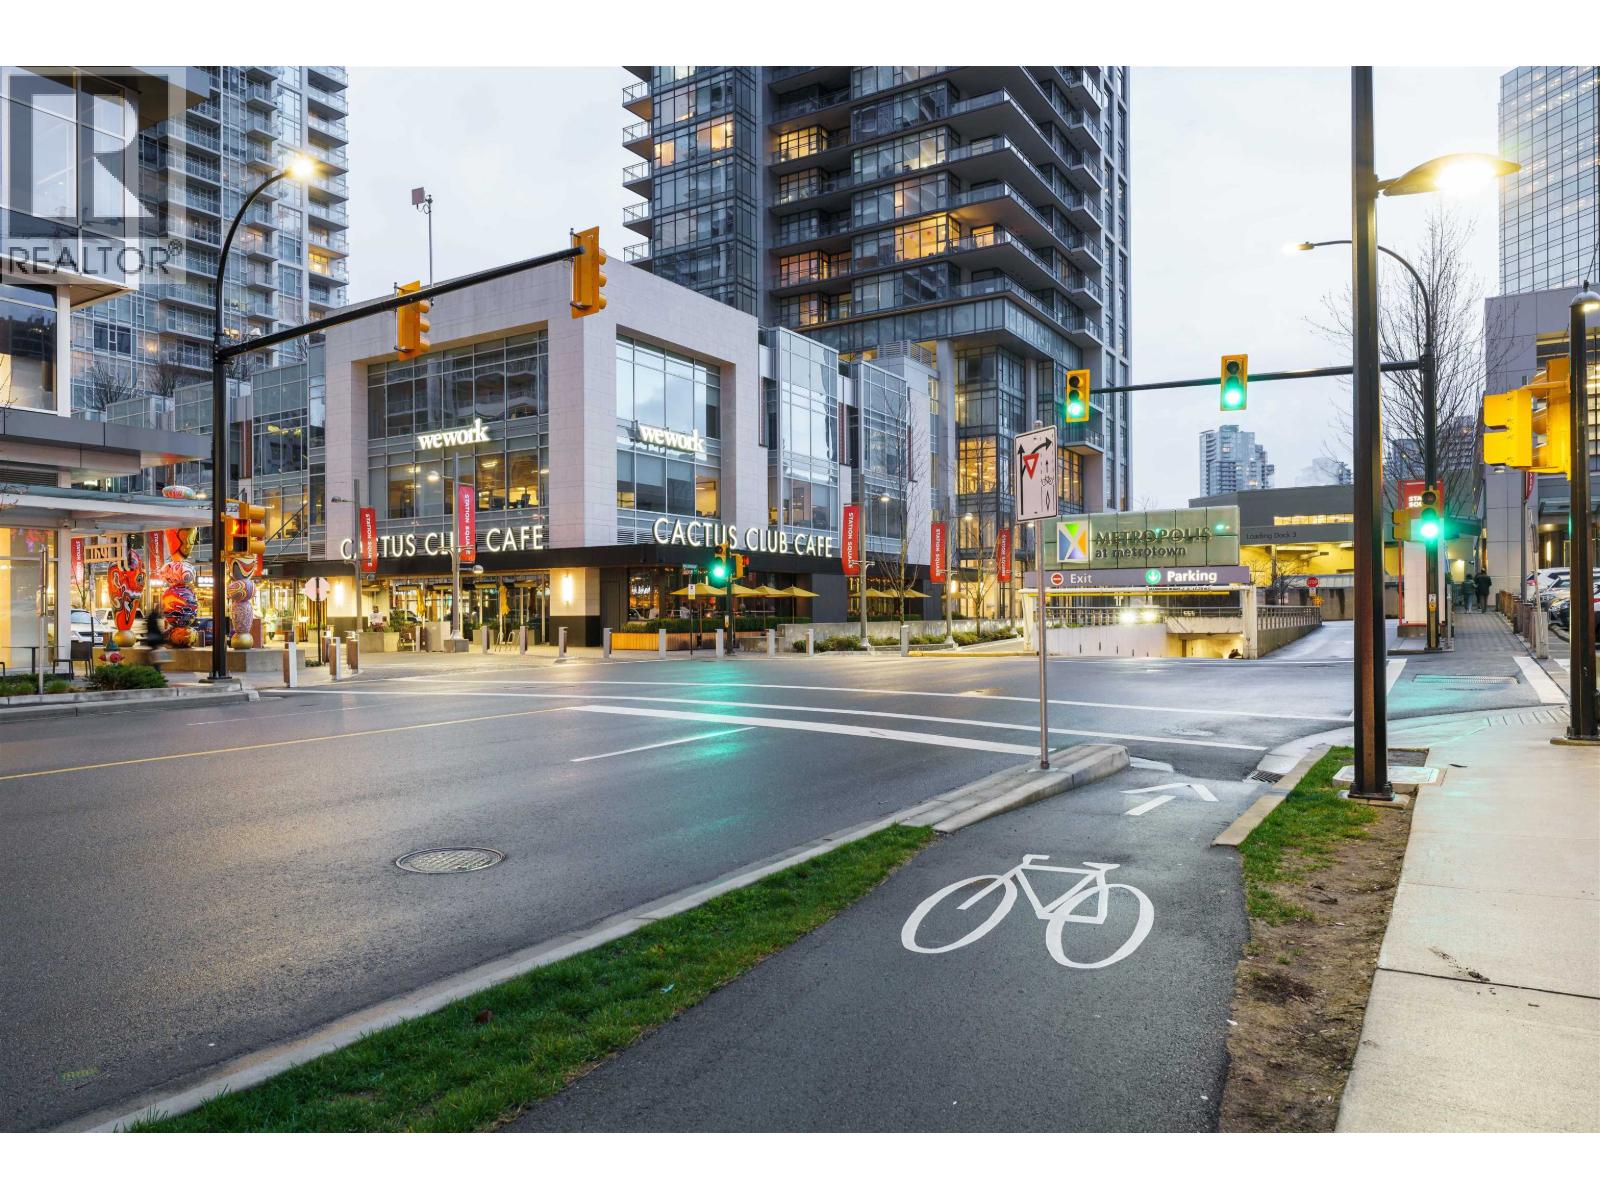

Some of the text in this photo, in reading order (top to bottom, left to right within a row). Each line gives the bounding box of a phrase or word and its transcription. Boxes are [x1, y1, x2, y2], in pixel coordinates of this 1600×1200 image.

[418, 418, 490, 449] wework
[638, 424, 706, 451] wework
[340, 534, 415, 560] CTUS
[486, 525, 544, 552] CAFE
[653, 518, 833, 558] CACTUS CLUB CAFE
[1095, 527, 1212, 545] METROPOLIS
[1095, 546, 1186, 558] at metrotown
[1070, 573, 1093, 584] Exit
[1167, 569, 1218, 584] Parking
